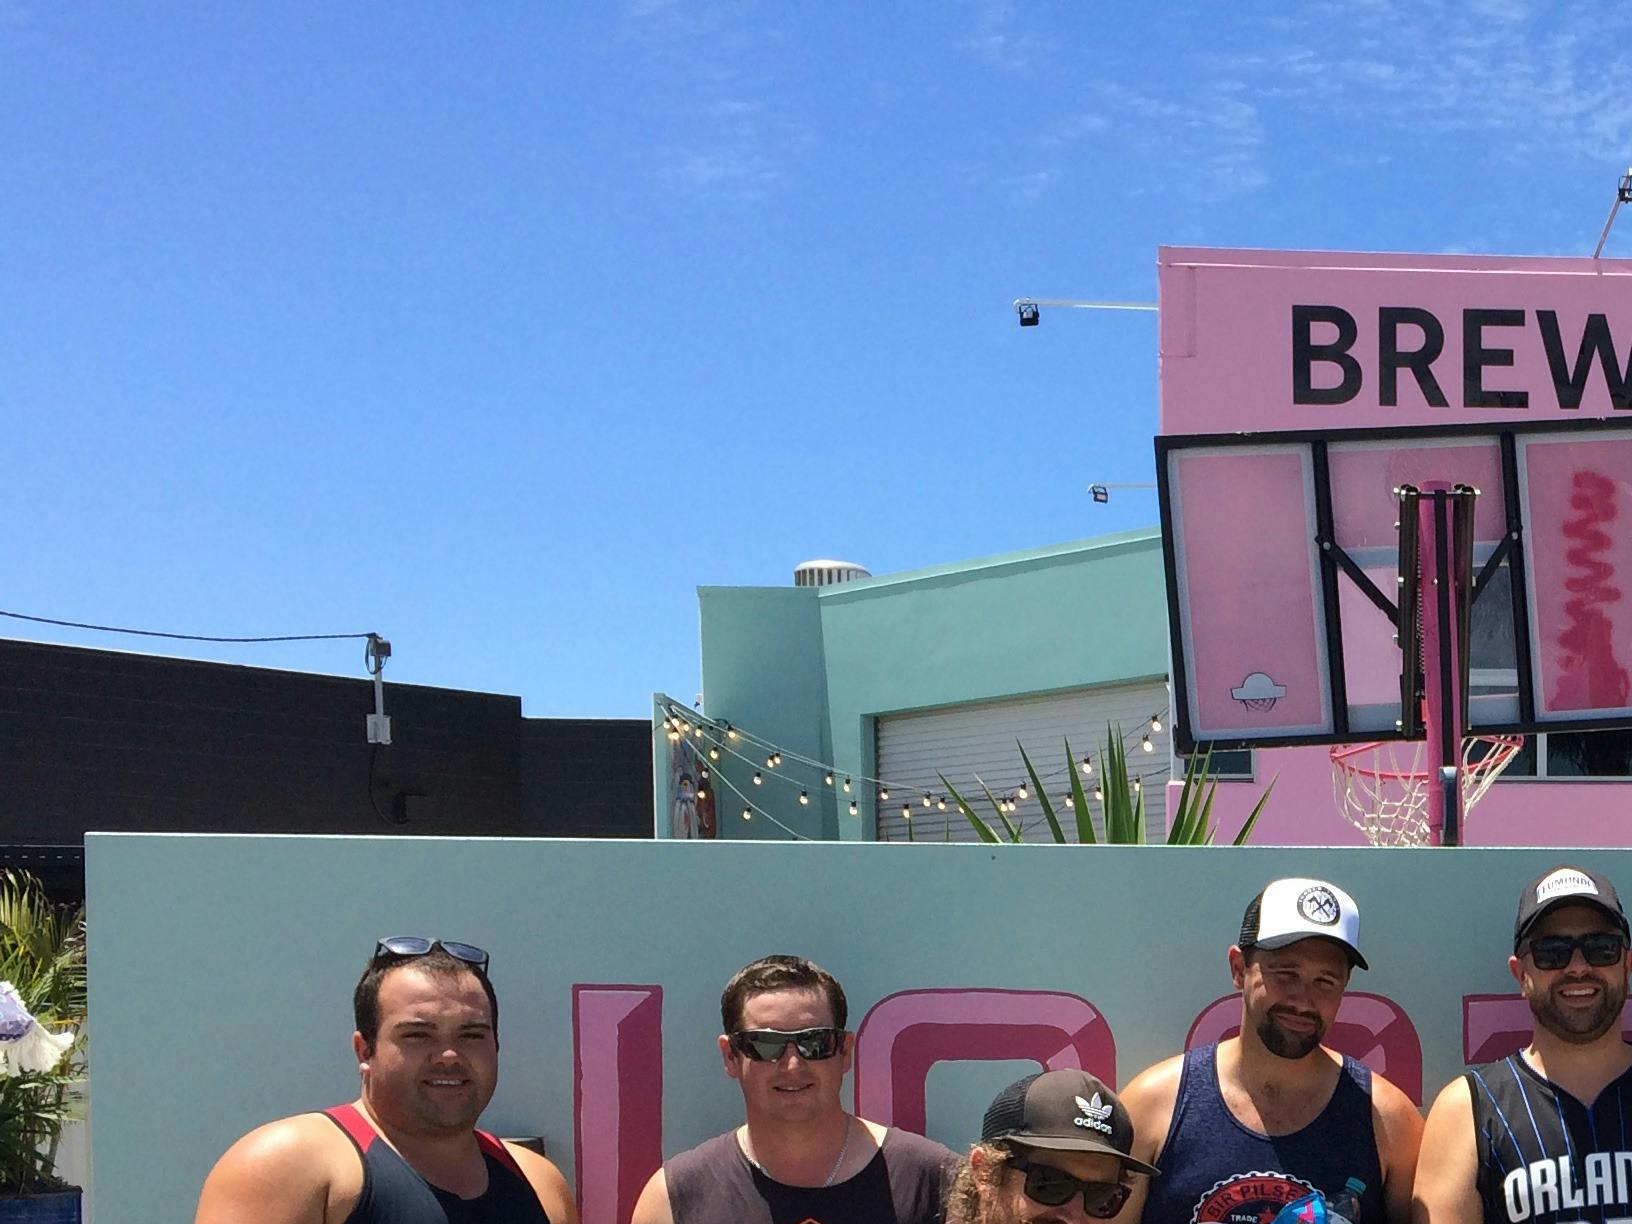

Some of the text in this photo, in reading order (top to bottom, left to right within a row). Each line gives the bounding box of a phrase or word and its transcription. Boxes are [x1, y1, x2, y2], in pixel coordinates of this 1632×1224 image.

[1073, 1117, 1112, 1135] adidas
[1207, 1192, 1237, 1218] BIR
[1231, 1214, 1258, 1223] TRADE
